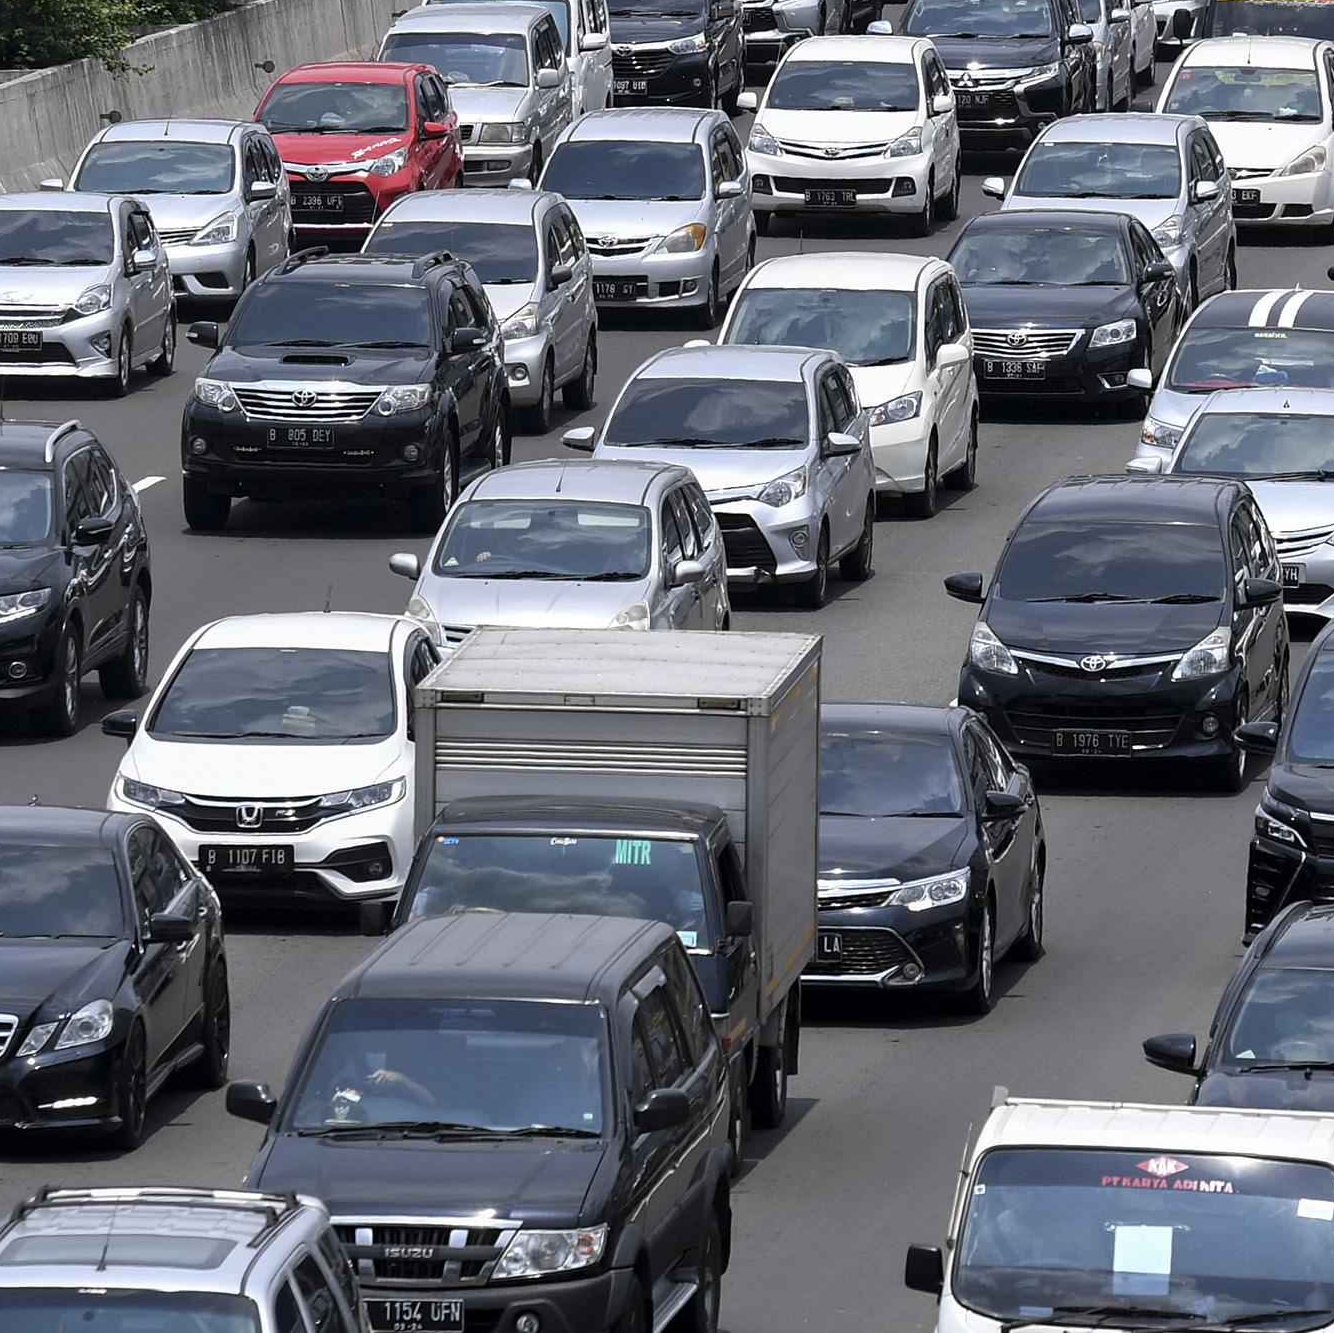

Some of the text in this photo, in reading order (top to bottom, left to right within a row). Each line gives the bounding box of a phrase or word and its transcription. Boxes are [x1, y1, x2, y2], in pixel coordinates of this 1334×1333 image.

[291, 197, 296, 205] B
[303, 197, 321, 205] 2396
[806, 192, 811, 201] B
[817, 192, 835, 201] 1763
[1242, 191, 1257, 200] EKF
[597, 284, 615, 293] 1178
[987, 362, 993, 372] B
[1002, 362, 1022, 372] 1336
[270, 430, 331, 441] B 805 DEY
[1056, 733, 1128, 748] B 1976 TYE
[209, 850, 285, 864] B 1107 FIB
[615, 840, 651, 864] MITR
[824, 937, 840, 952] LA
[1148, 1158, 1176, 1175] KAK
[1102, 1177, 1119, 1186] PT
[1122, 1178, 1167, 1189] KARYA
[385, 1248, 433, 1258] ISUZU
[385, 1302, 460, 1322] 1154 UFN
